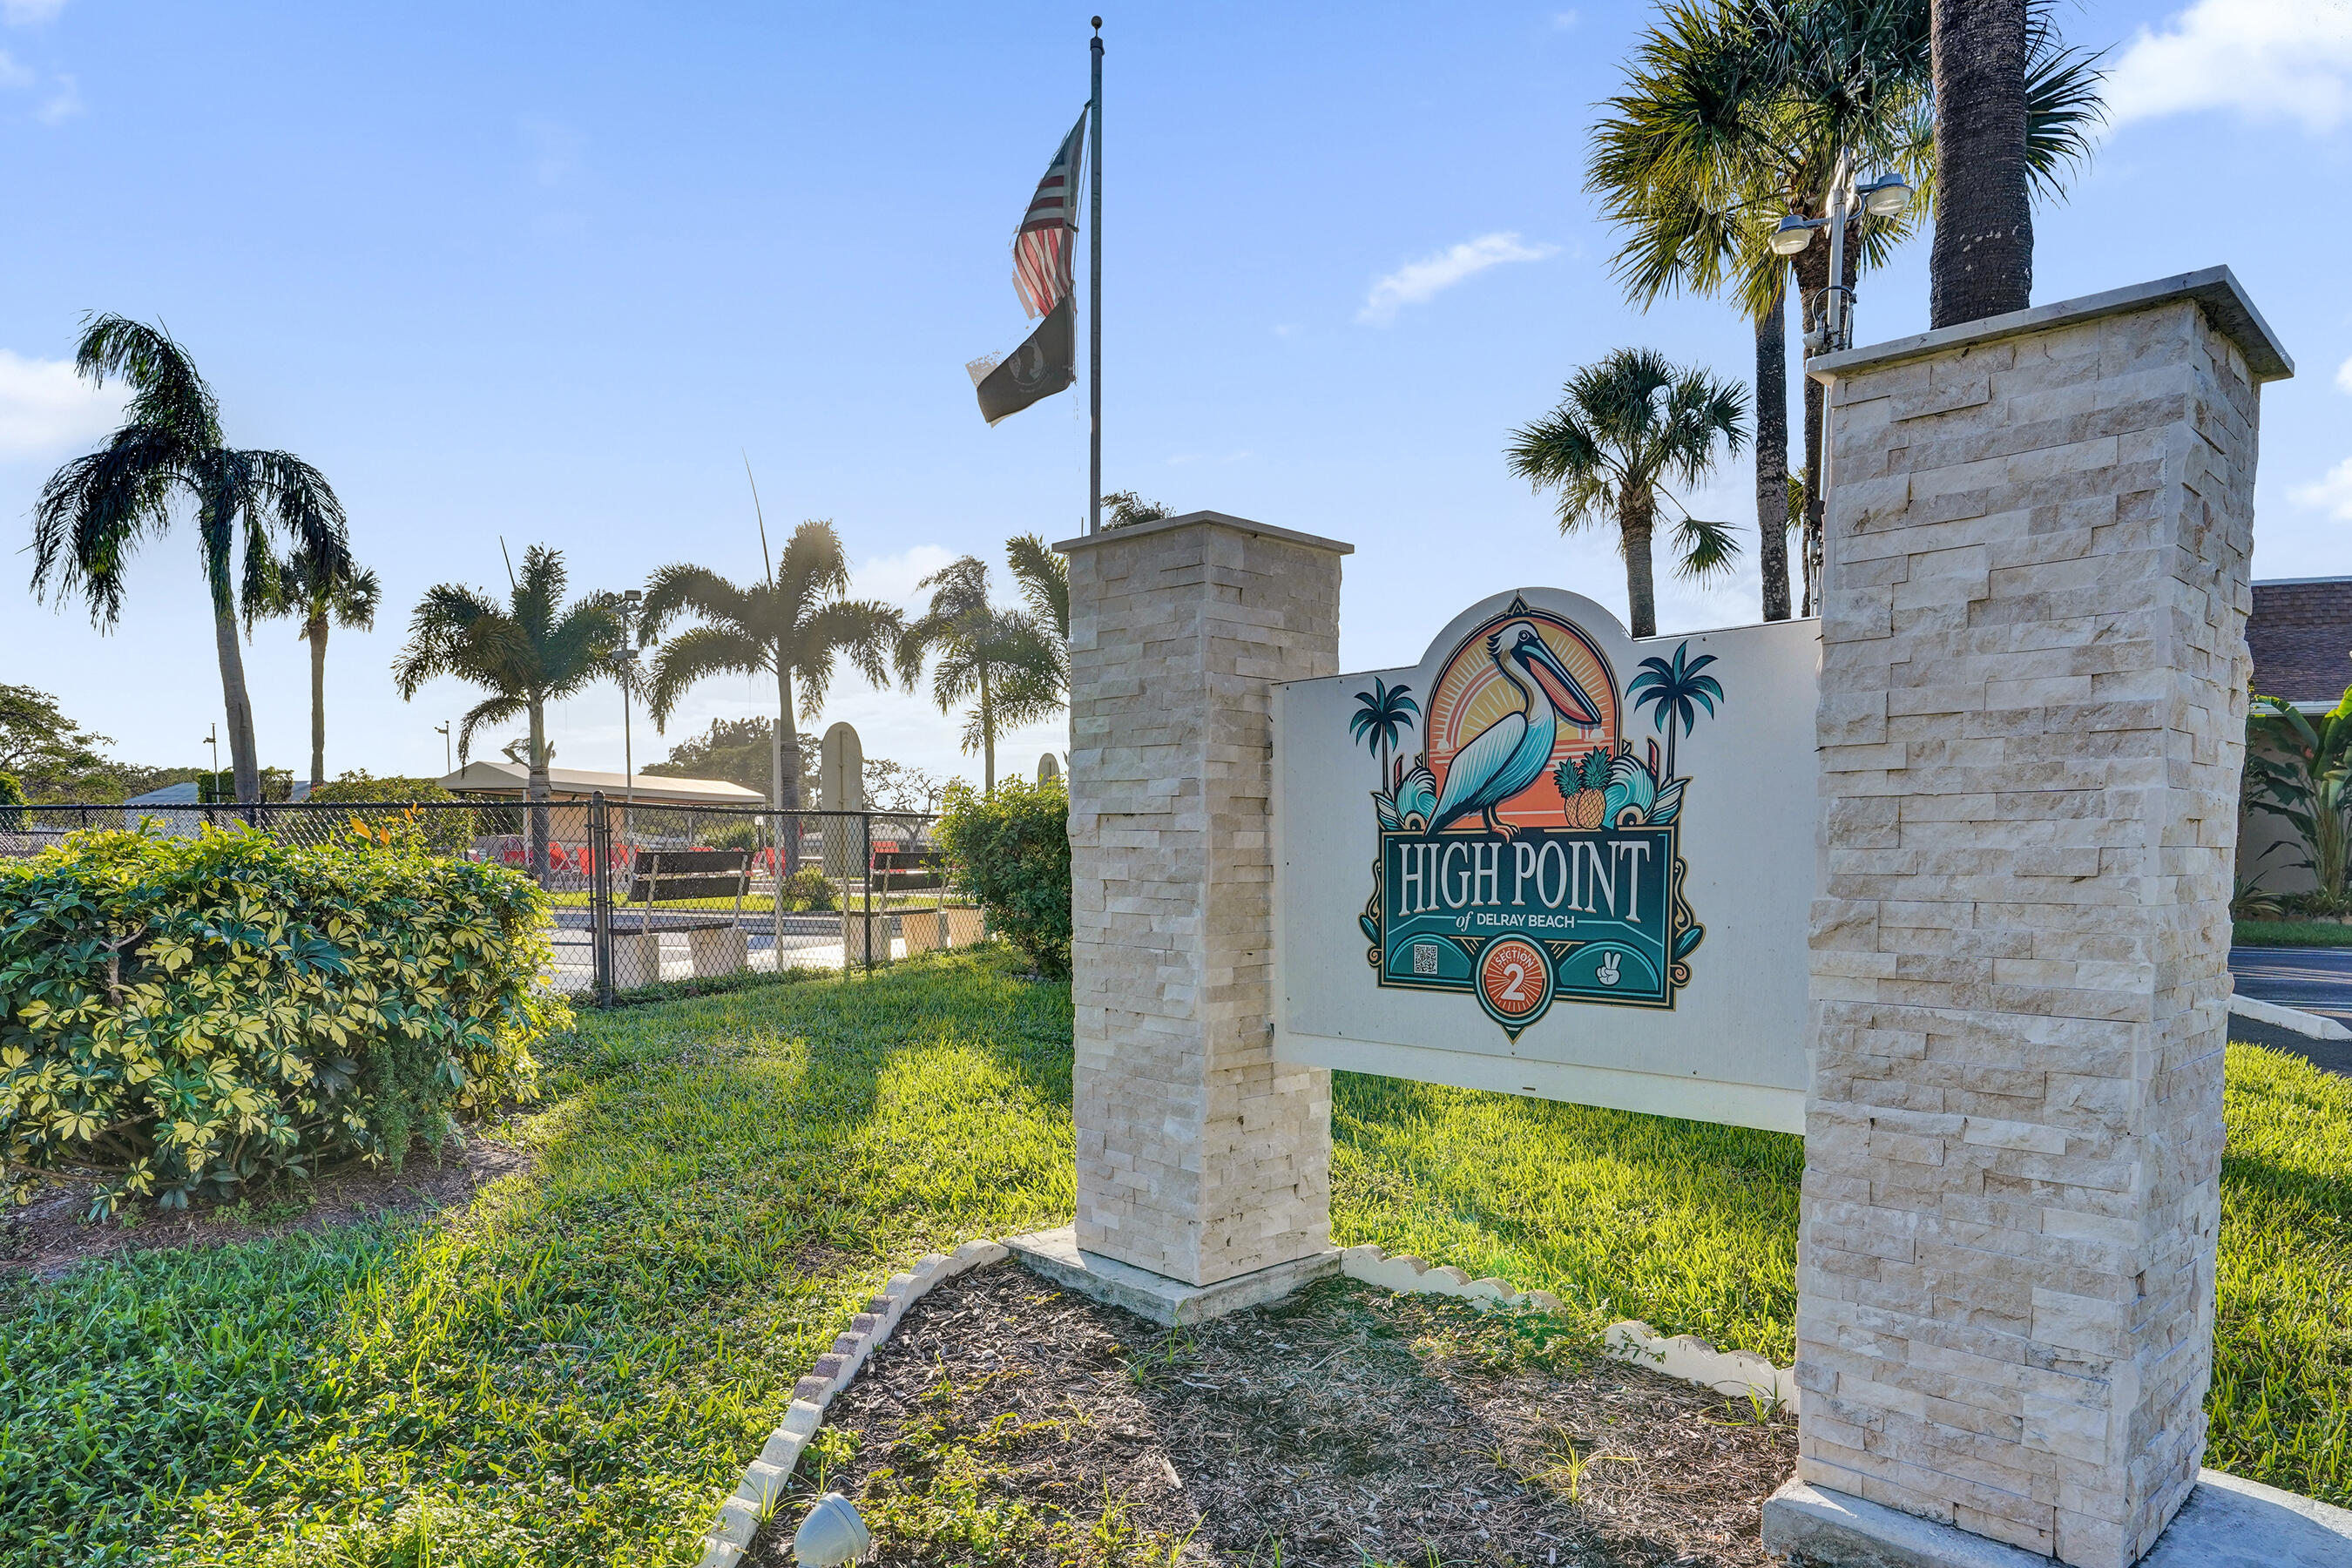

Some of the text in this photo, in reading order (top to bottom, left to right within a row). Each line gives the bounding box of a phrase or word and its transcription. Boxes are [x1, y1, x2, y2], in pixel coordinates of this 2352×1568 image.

[1398, 841, 1651, 923] HIGH POINT
[1456, 911, 1575, 932] of DELRAY BEACH
[1495, 950, 1534, 969] SECTION
[1501, 963, 1525, 1001] 2
